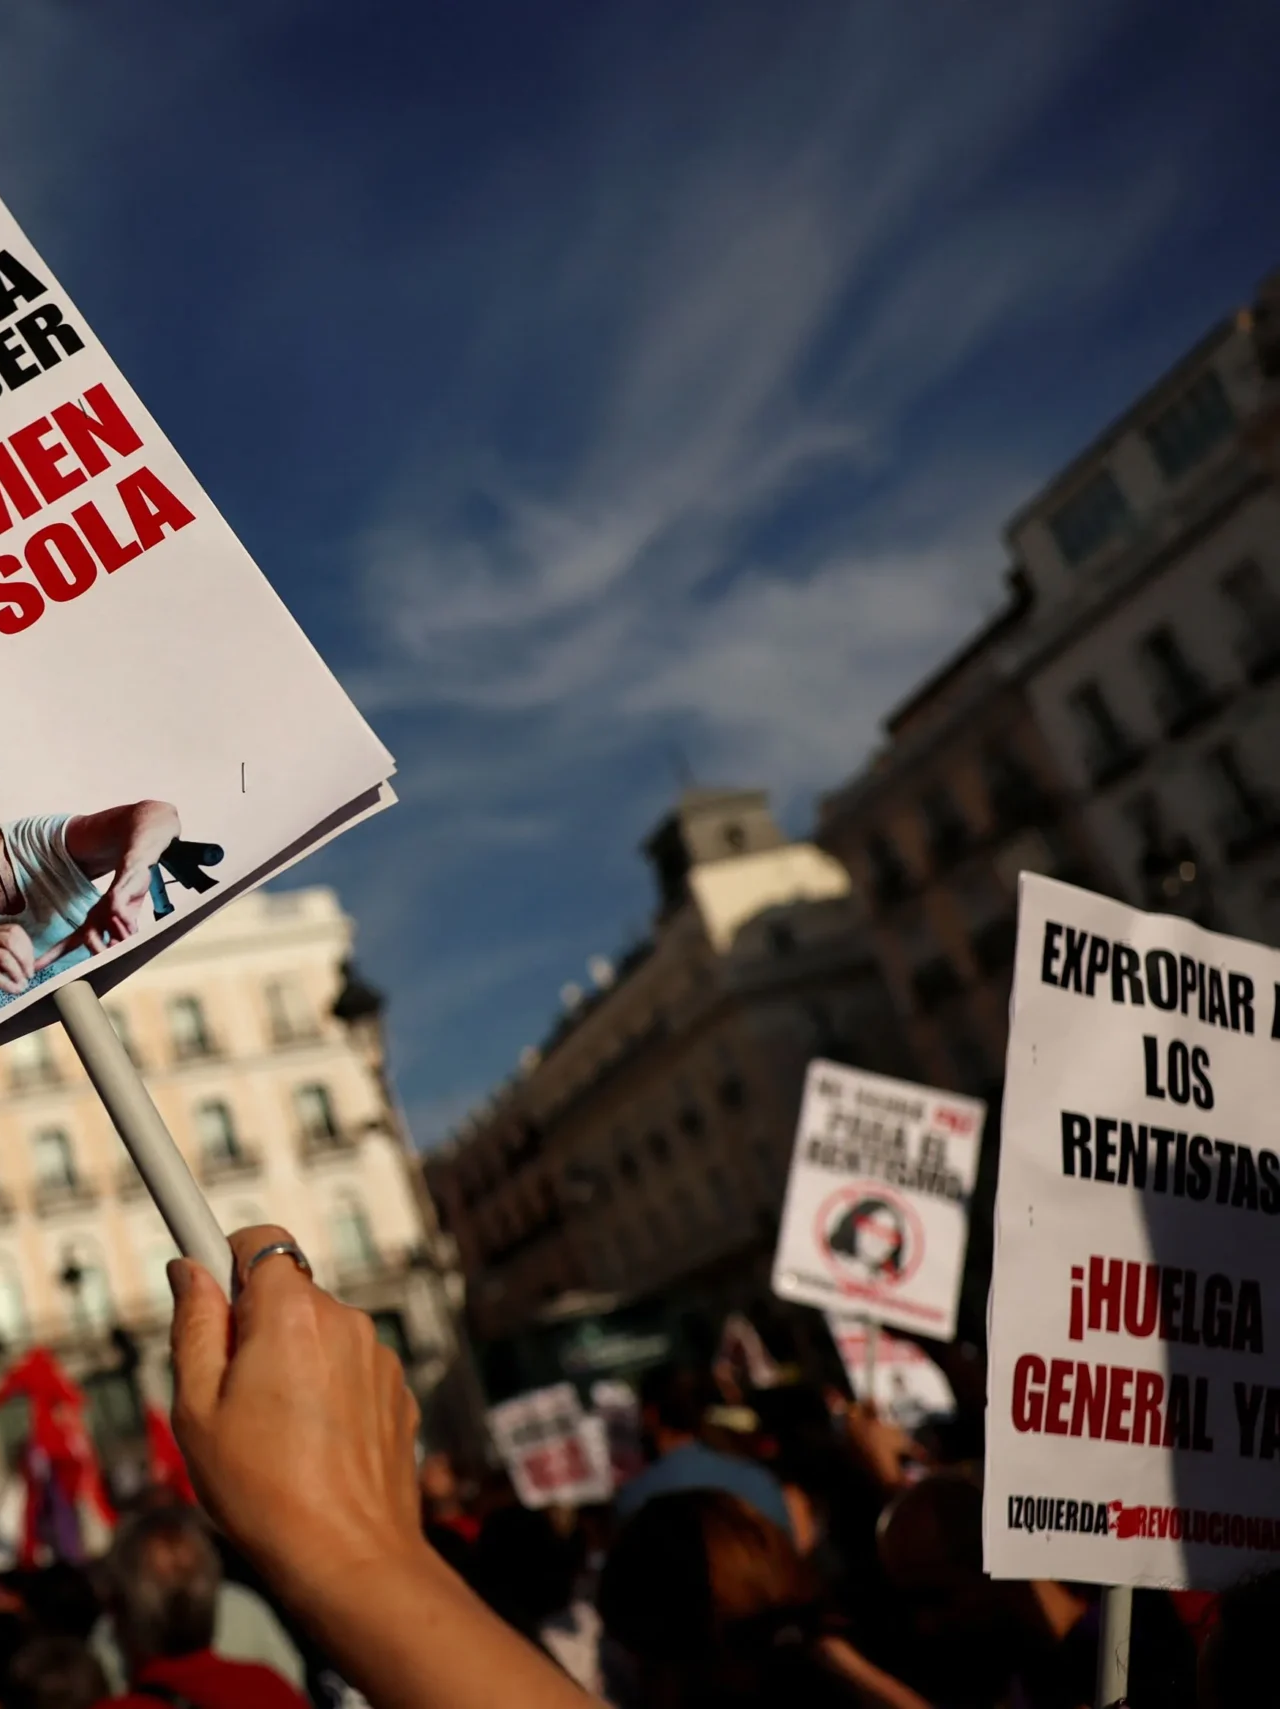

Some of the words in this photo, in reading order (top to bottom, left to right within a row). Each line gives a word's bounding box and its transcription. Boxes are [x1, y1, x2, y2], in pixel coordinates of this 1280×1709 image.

[1041, 920, 1255, 1035] EXPROPIAR
[1143, 1035, 1214, 1110] LOS
[1061, 1109, 1280, 1216] RENTISTAS
[1069, 1255, 1263, 1354] ¡HUELGA
[1011, 1353, 1213, 1453] GENERAL
[1233, 1381, 1280, 1460] YA
[1008, 1495, 1108, 1536] IZQUIERDA
